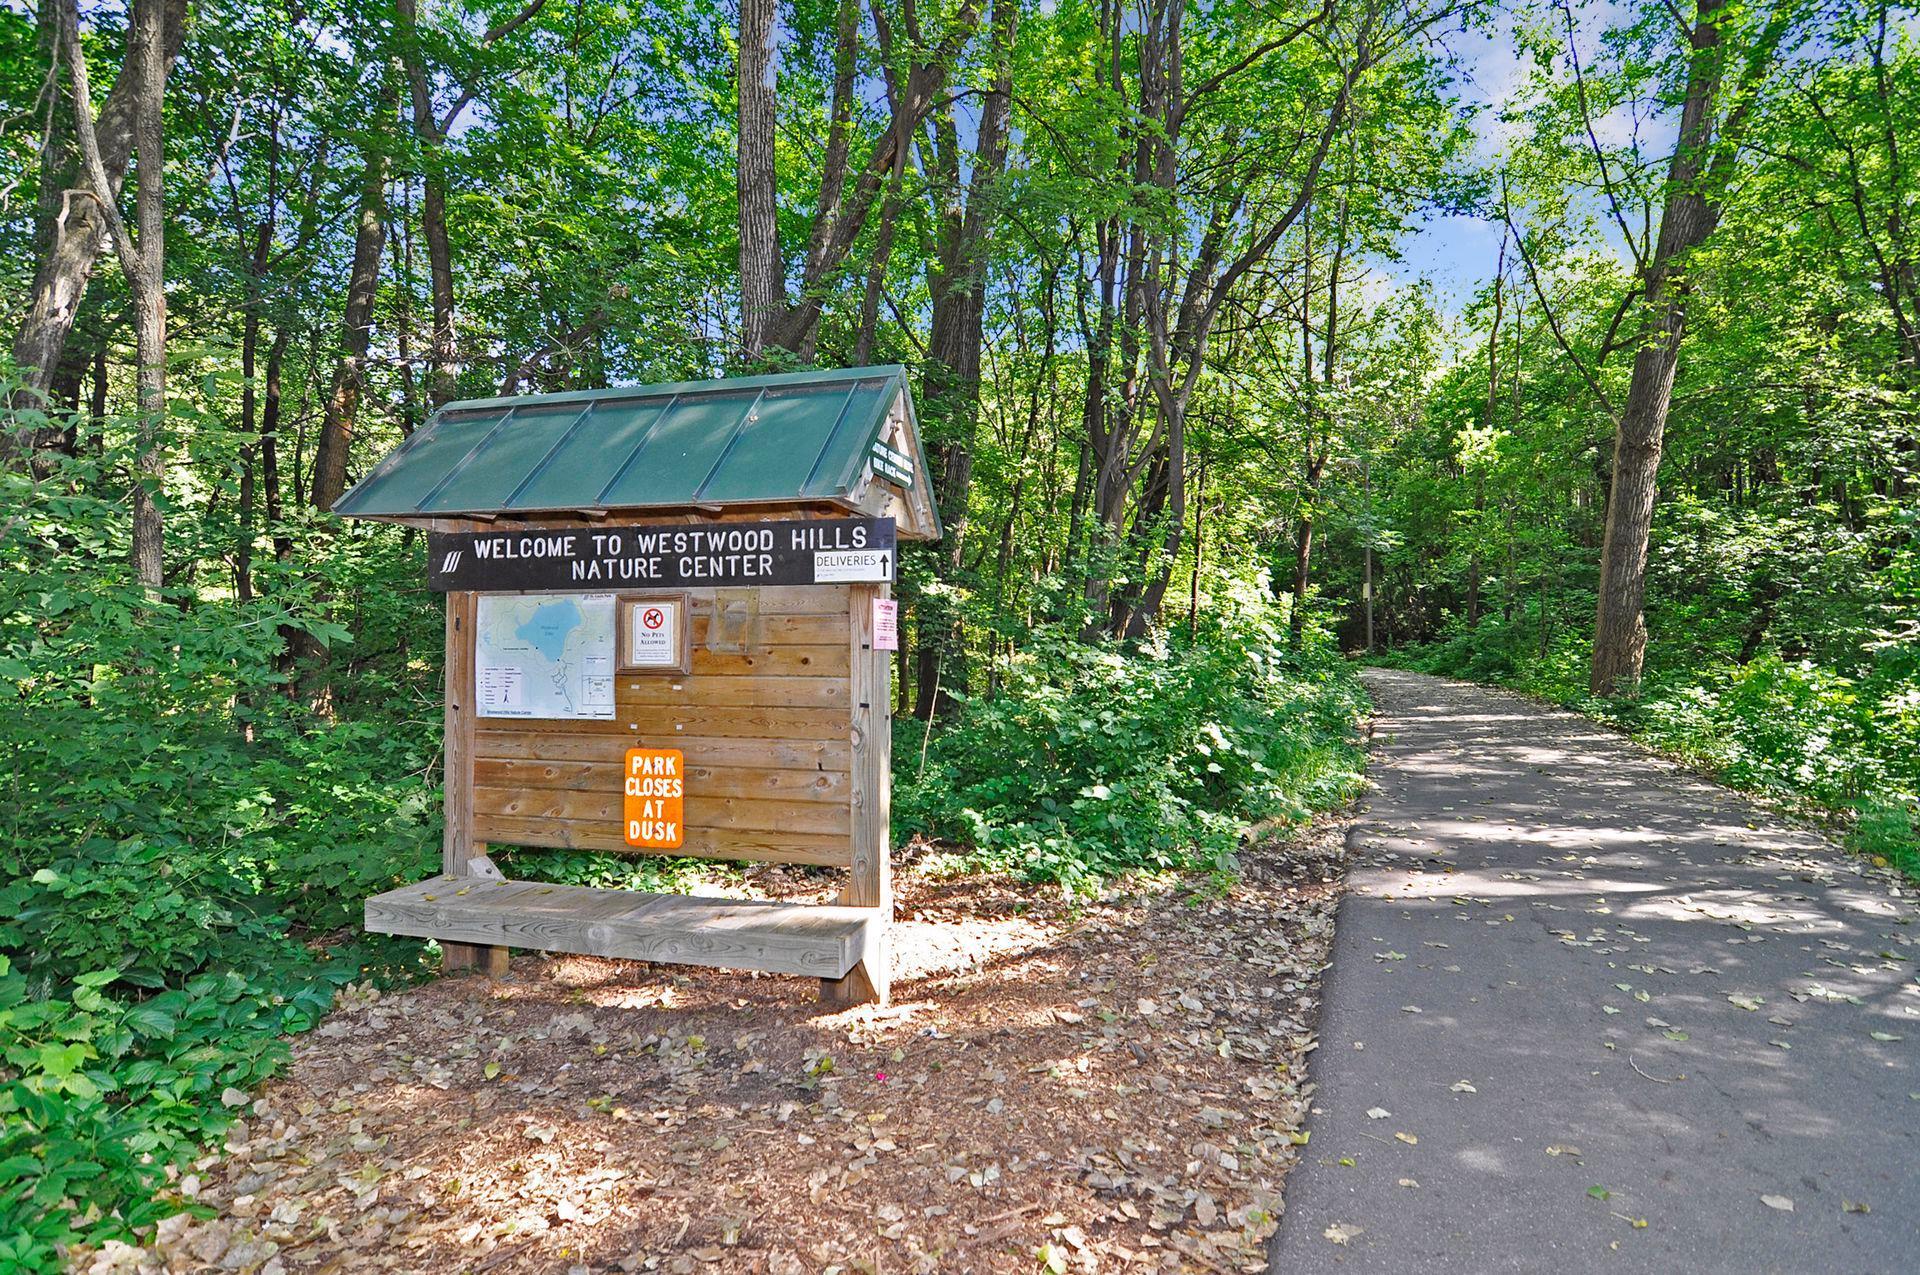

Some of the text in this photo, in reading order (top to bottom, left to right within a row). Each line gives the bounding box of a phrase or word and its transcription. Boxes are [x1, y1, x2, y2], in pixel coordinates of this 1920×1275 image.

[473, 526, 867, 559] WELCOME TO WESTWOOD HILLS
[572, 554, 773, 580] NATURE CENTER
[816, 555, 876, 567] DELIVERIES
[632, 755, 676, 775] PARK
[624, 777, 682, 798] CLOSES
[643, 800, 665, 819] AT
[629, 820, 677, 842] DUSK
